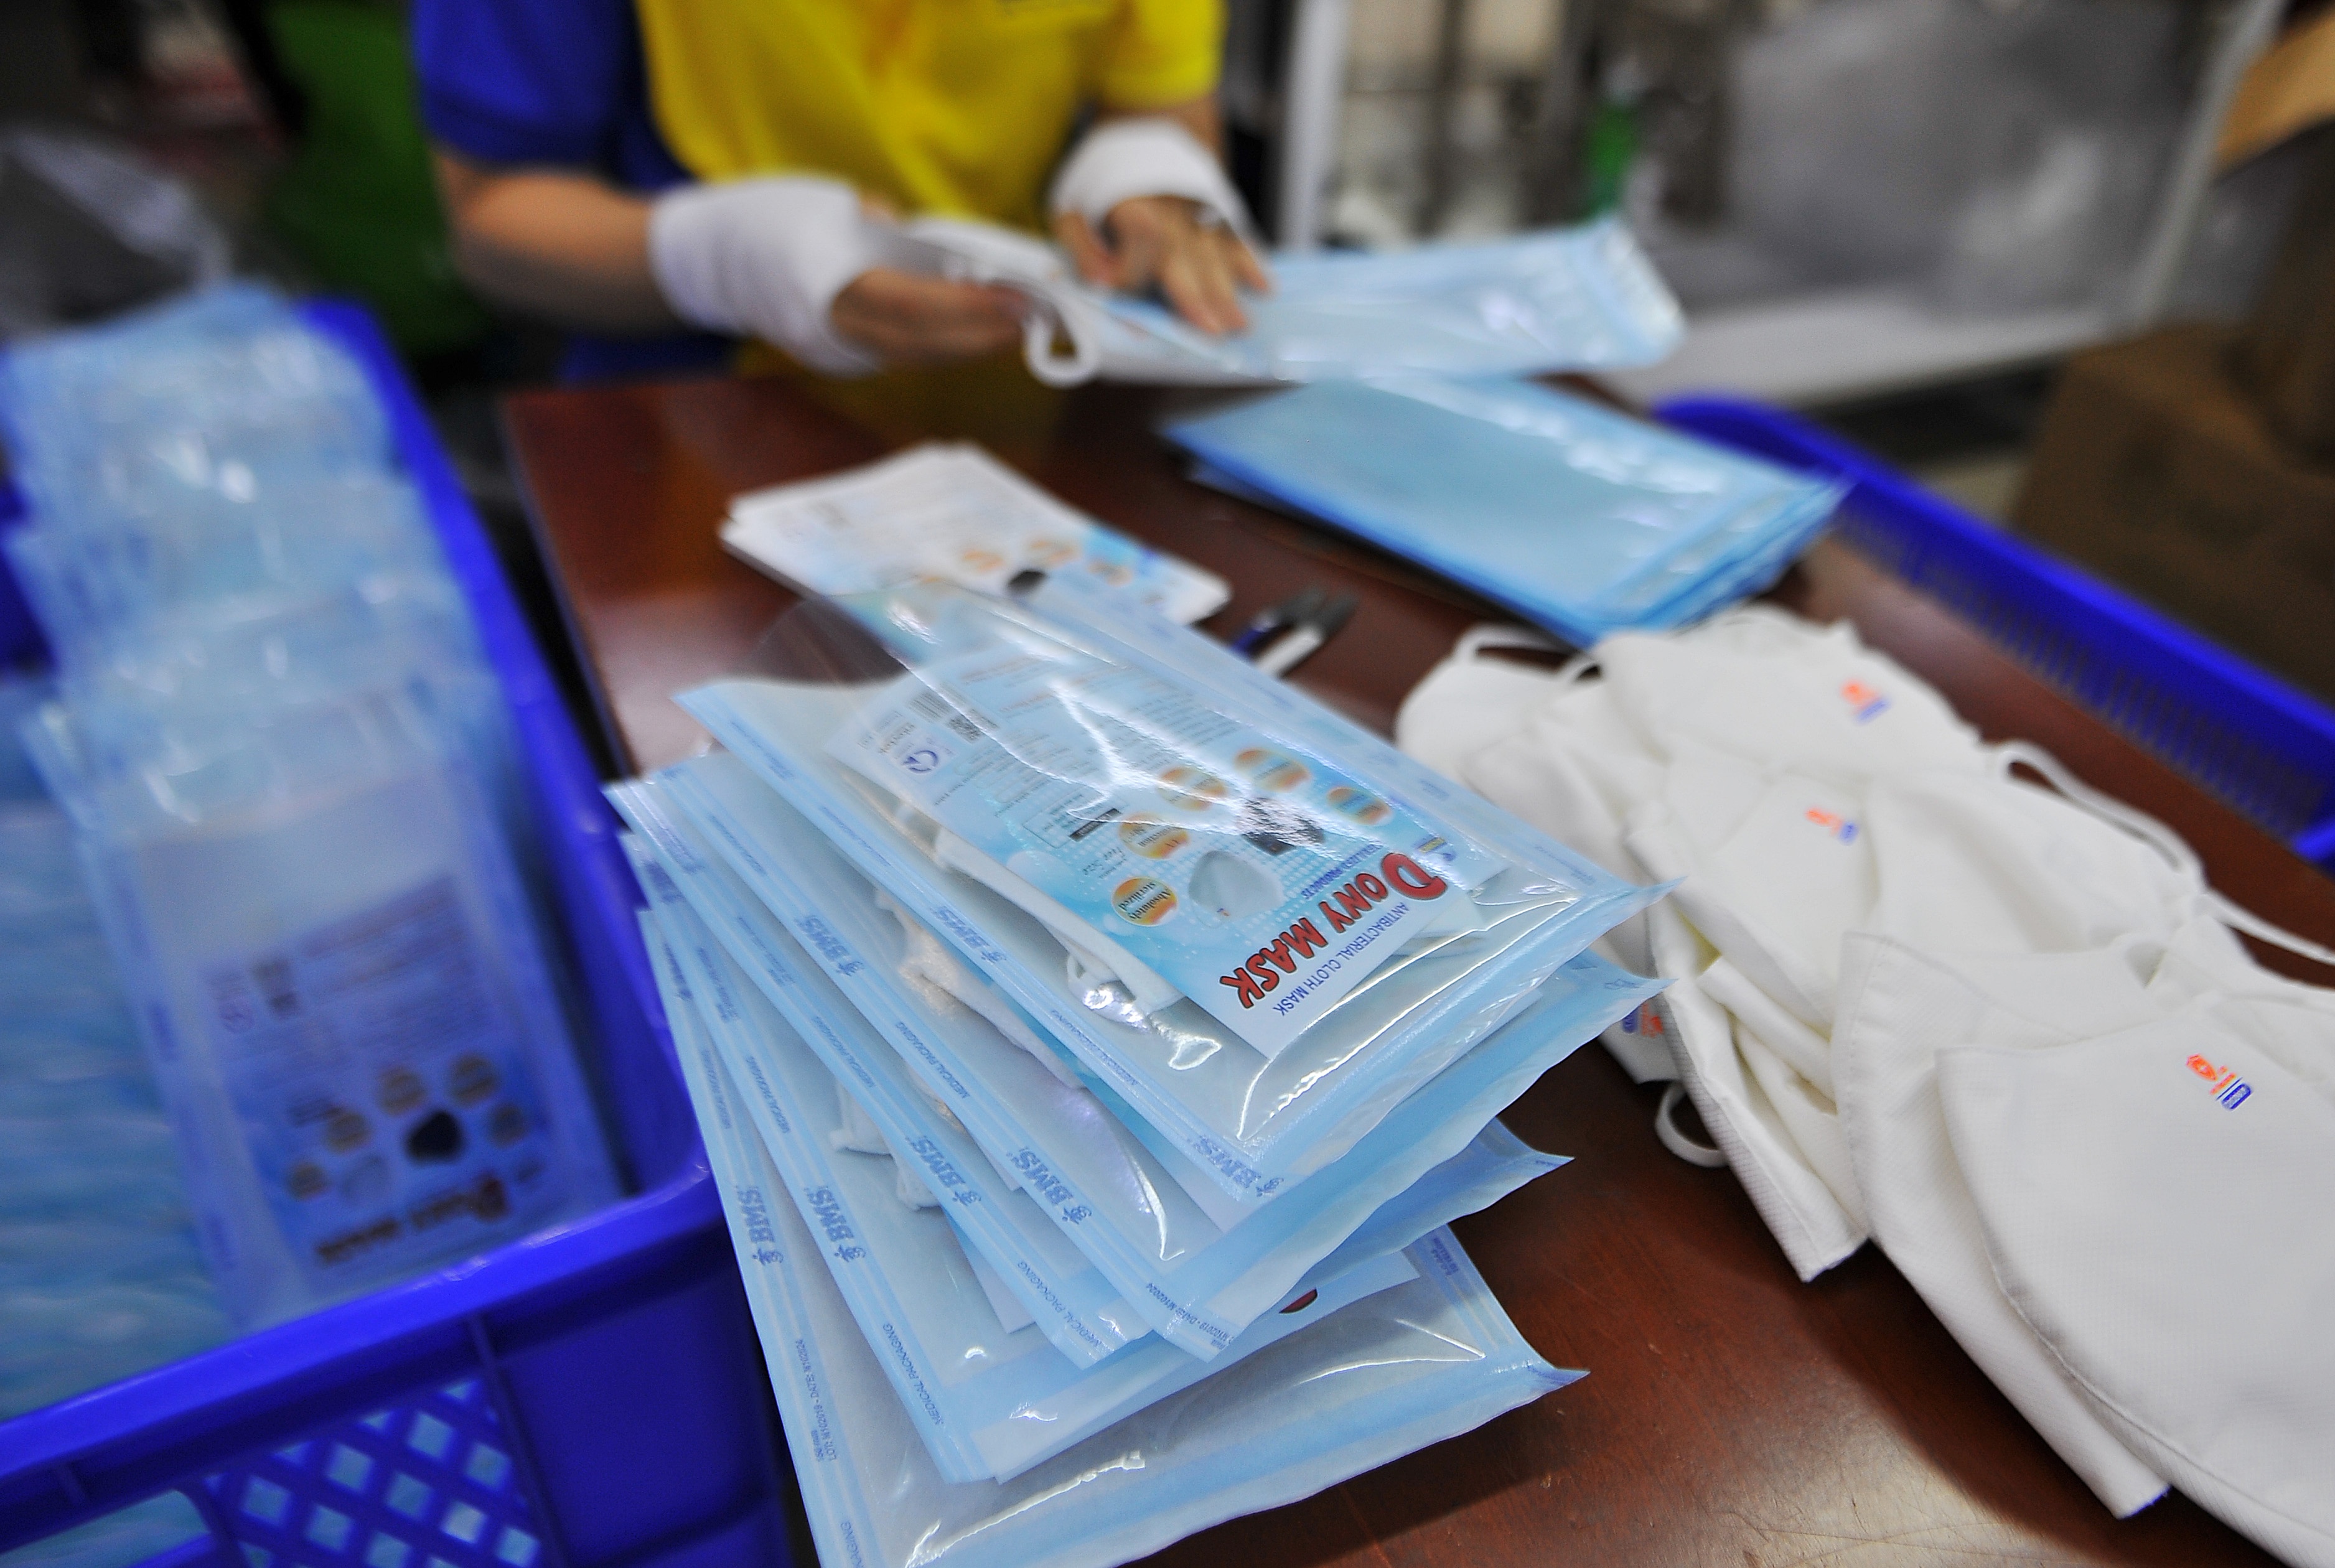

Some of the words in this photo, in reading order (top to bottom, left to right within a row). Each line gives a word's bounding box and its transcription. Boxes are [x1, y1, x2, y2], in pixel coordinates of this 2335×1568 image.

[1118, 880, 1156, 911] sterilized
[1128, 888, 1170, 922] Absolutely
[1336, 902, 1410, 962] ANTIBACTERIAL
[1220, 917, 1329, 1009] MASK
[1303, 954, 1342, 994] CLOTH
[1276, 987, 1311, 1015] MASK
[895, 1020, 939, 1065] PACKAGING
[935, 1063, 970, 1099] MEDICAL
[1016, 1260, 1066, 1313] PACKAGING
[1145, 1282, 1177, 1310] M102024
[1062, 1312, 1101, 1346] MEDICAL
[882, 1323, 920, 1379] PACKAGING
[805, 1374, 819, 1398] DATE:
[912, 1379, 943, 1426] MEDICAL
